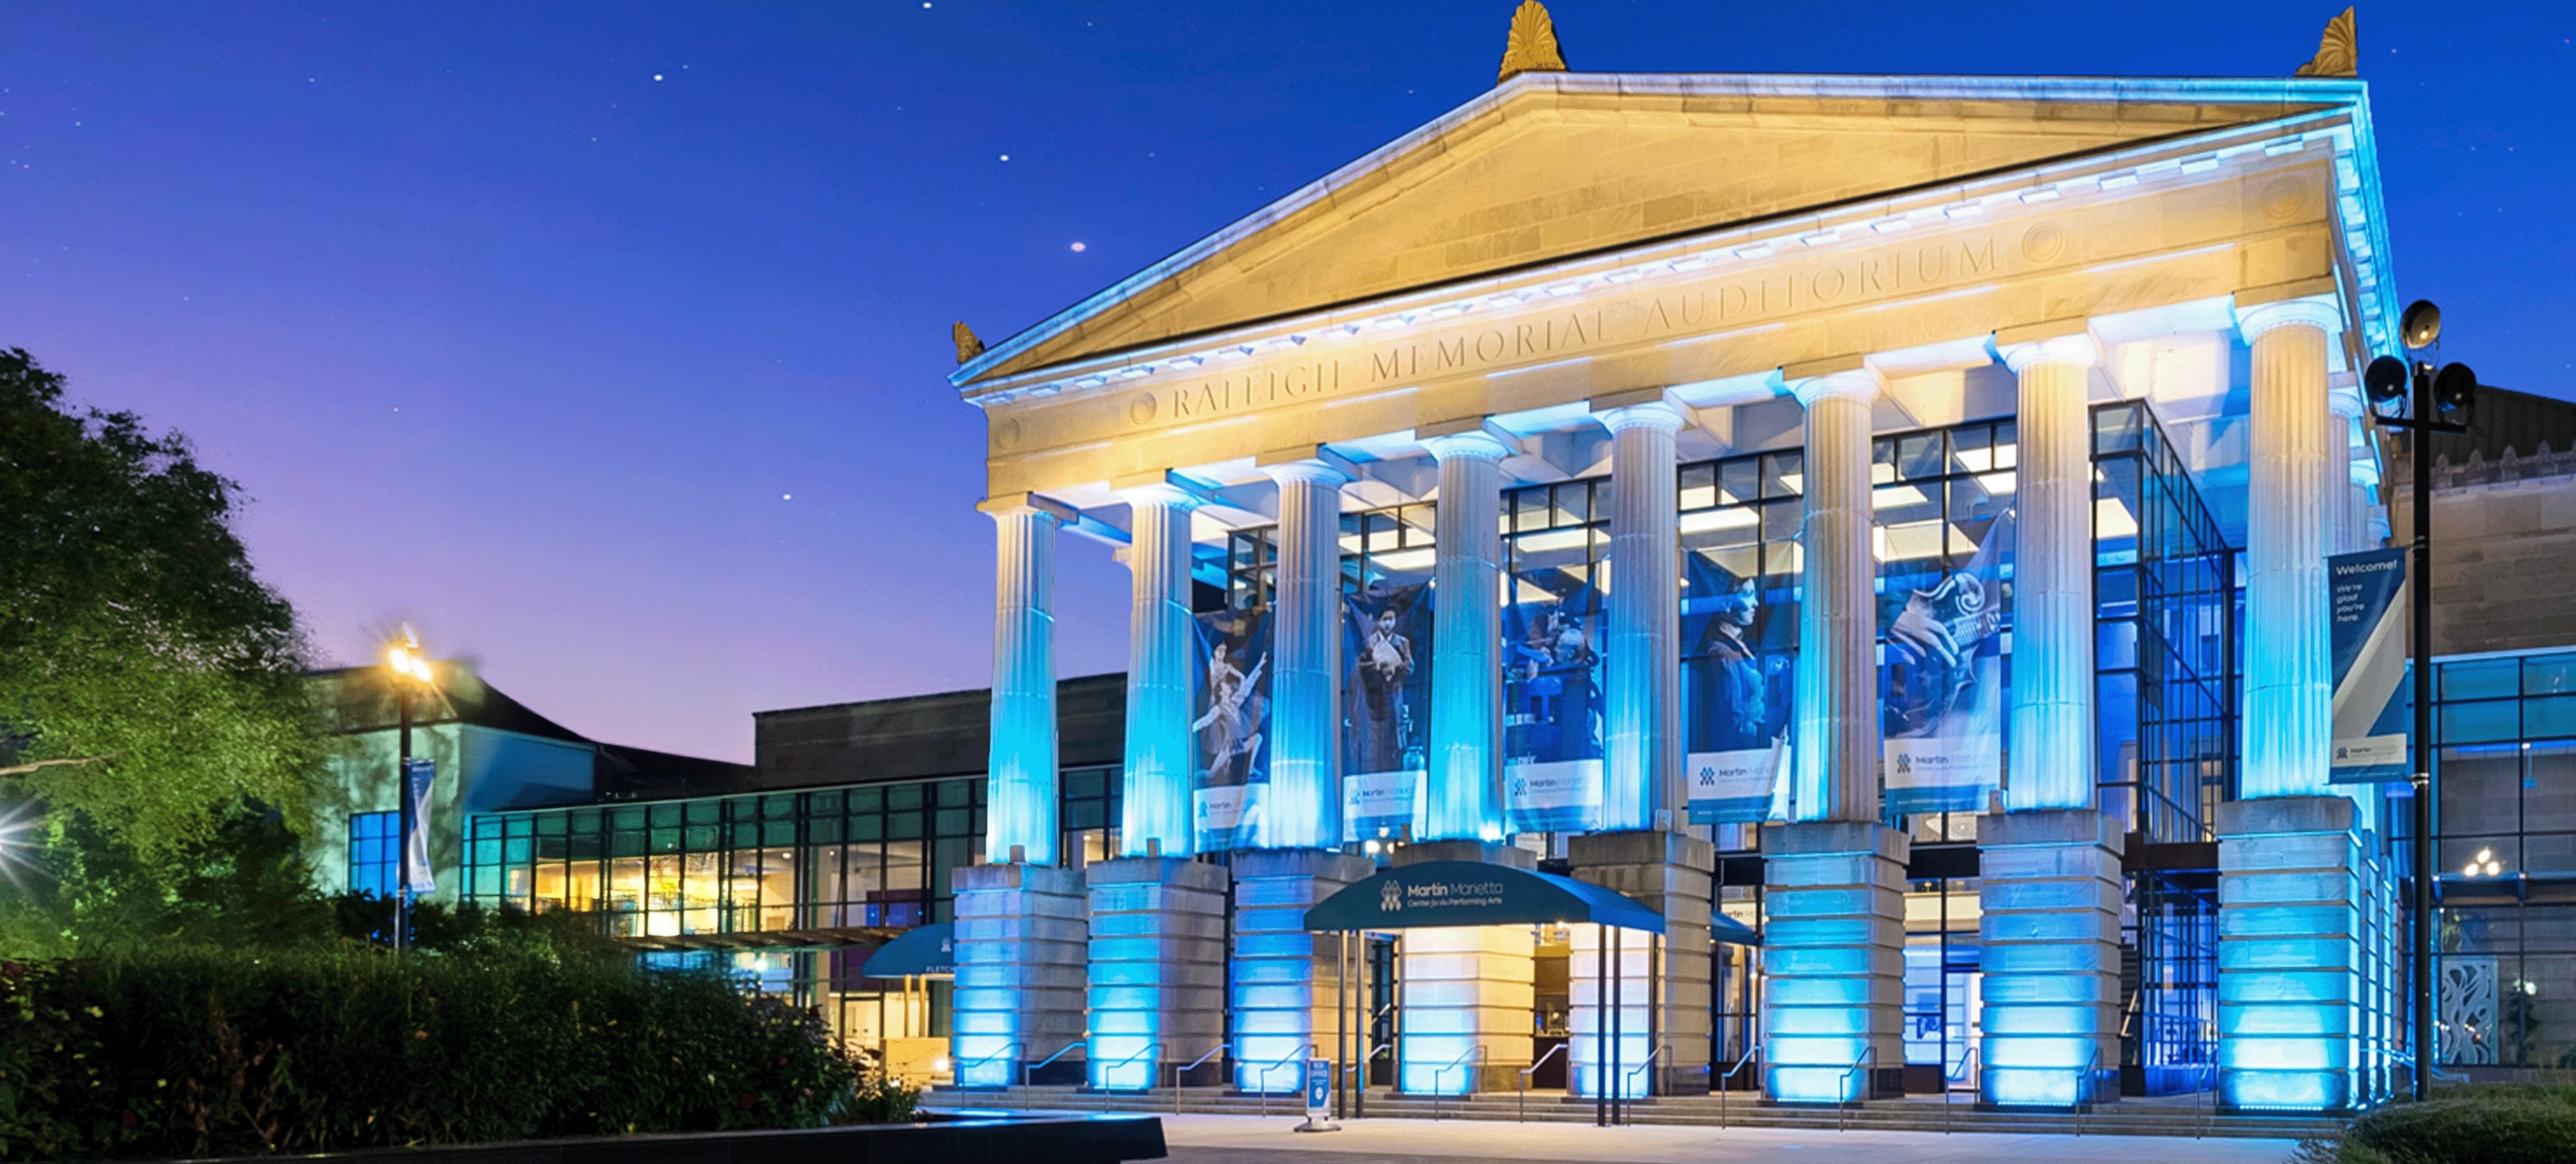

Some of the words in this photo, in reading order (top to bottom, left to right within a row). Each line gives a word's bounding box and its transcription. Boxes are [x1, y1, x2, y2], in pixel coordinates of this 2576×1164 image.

[1173, 360, 1340, 419] RALEIGH
[1371, 310, 1614, 382] MEMORIAL
[1643, 236, 1997, 333] AUDITORIUM
[2336, 559, 2397, 575] Welcome!
[1916, 755, 1949, 765] Martin
[1719, 768, 1747, 777] Martin
[1407, 882, 1448, 897] Martin
[1450, 881, 1503, 896] Marietta
